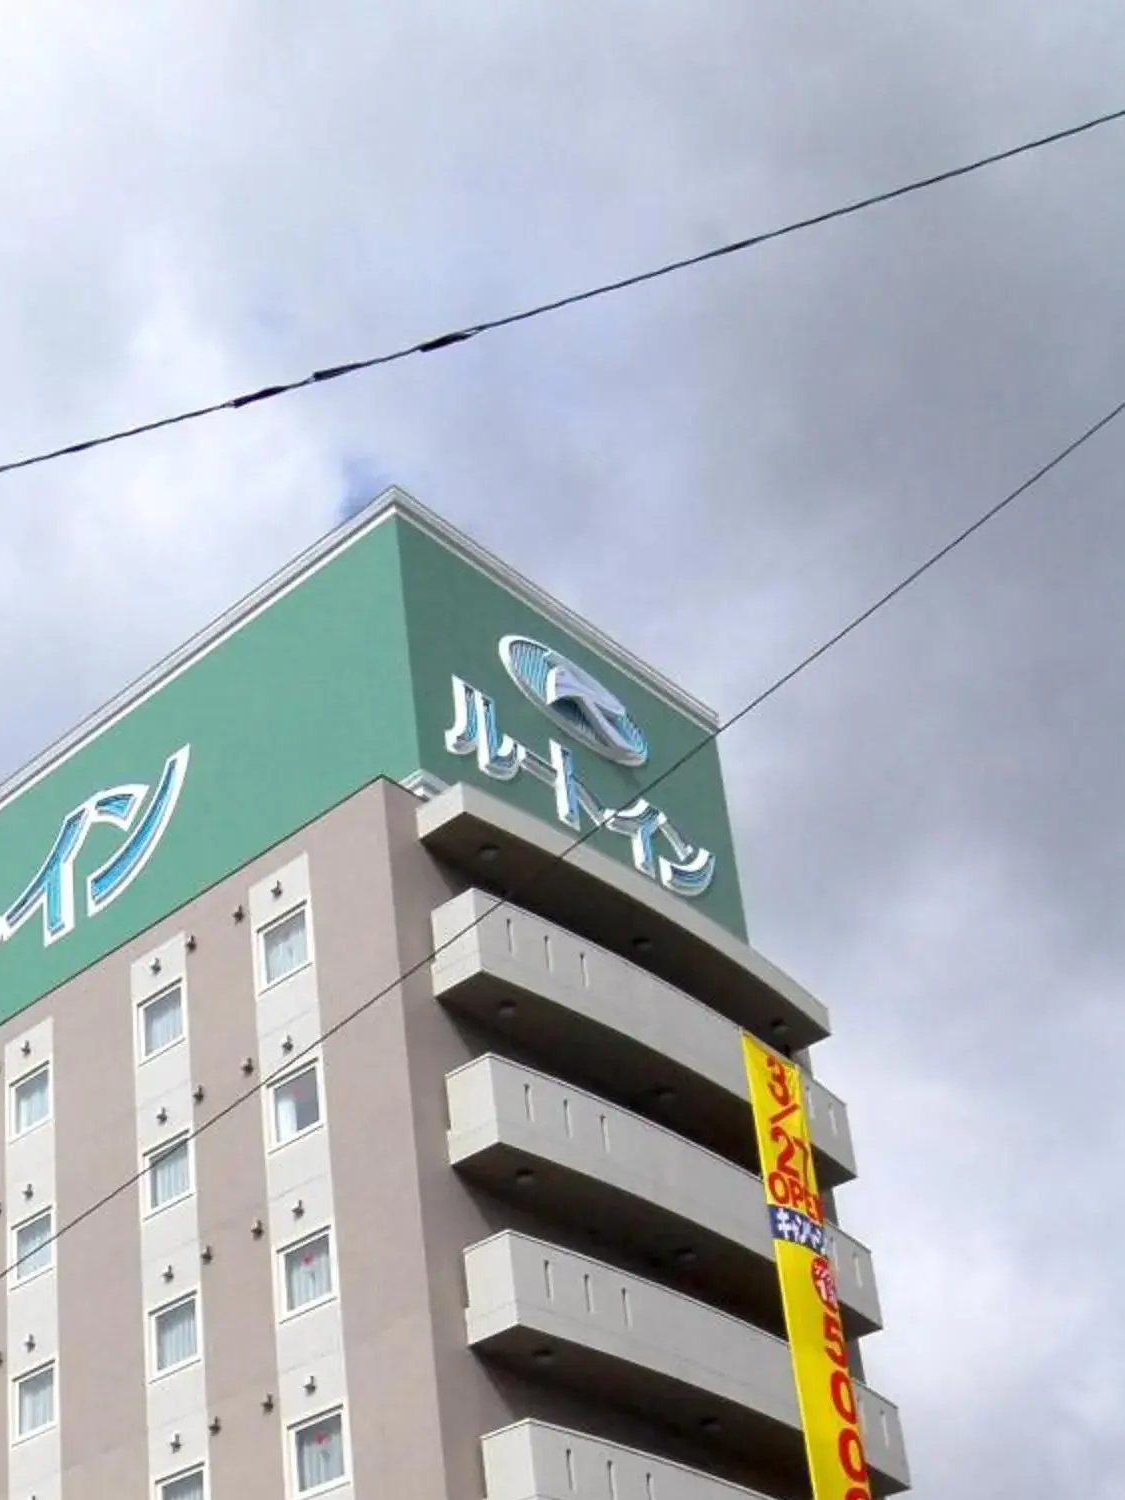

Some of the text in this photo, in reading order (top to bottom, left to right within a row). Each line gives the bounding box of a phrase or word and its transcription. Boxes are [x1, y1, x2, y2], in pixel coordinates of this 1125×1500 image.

[444, 674, 715, 896] ルートイン
